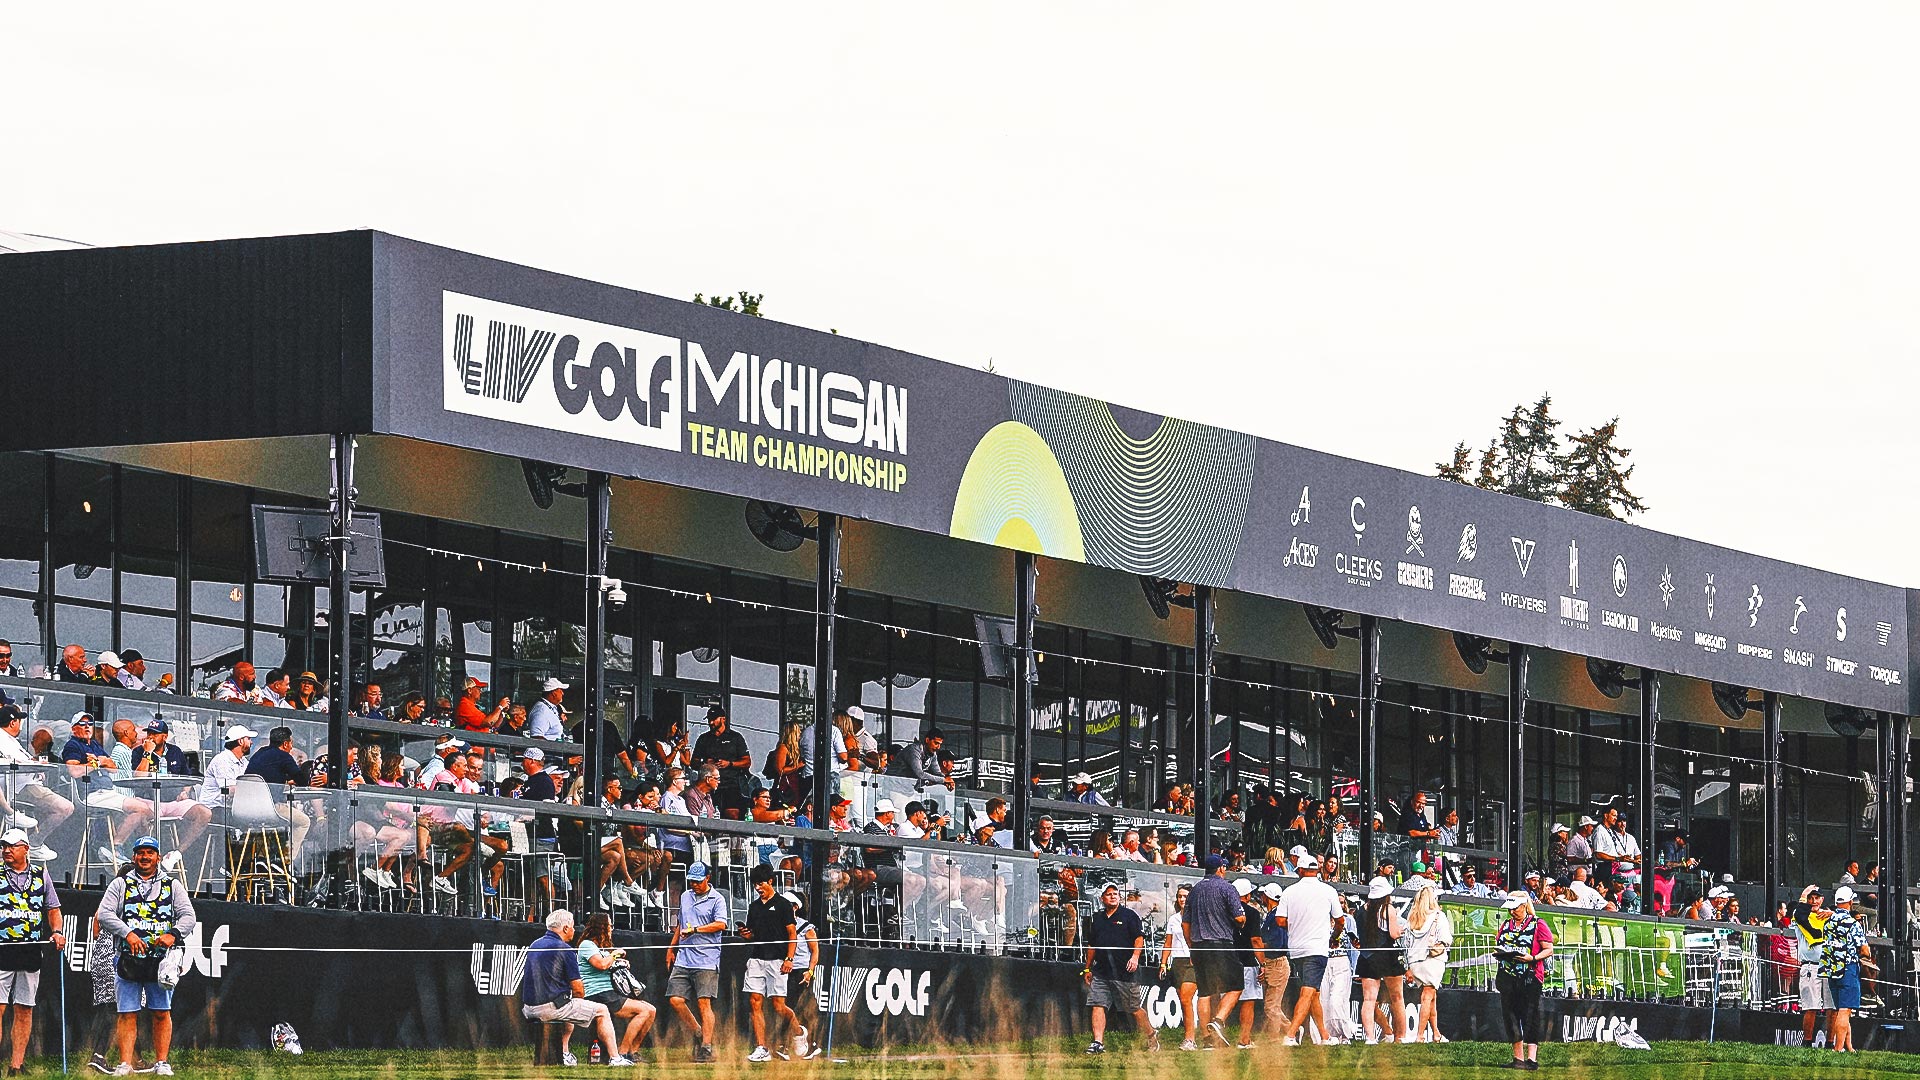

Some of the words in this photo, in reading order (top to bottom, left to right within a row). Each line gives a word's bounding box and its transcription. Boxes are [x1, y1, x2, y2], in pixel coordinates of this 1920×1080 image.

[453, 313, 556, 404] LIV
[553, 333, 672, 429] GOLF
[687, 341, 908, 456] MICHIGAN
[687, 422, 748, 464] TEAM
[752, 434, 907, 493] CHAMPIONSHIP
[1335, 552, 1383, 581] CLEEKS
[1602, 610, 1628, 630] LEGION
[1783, 648, 1813, 668] SMASH
[1826, 656, 1856, 676] STINGER
[1869, 665, 1900, 686] TORQUE
[812, 964, 868, 1013] LIV
[865, 967, 931, 1017] GOLF
